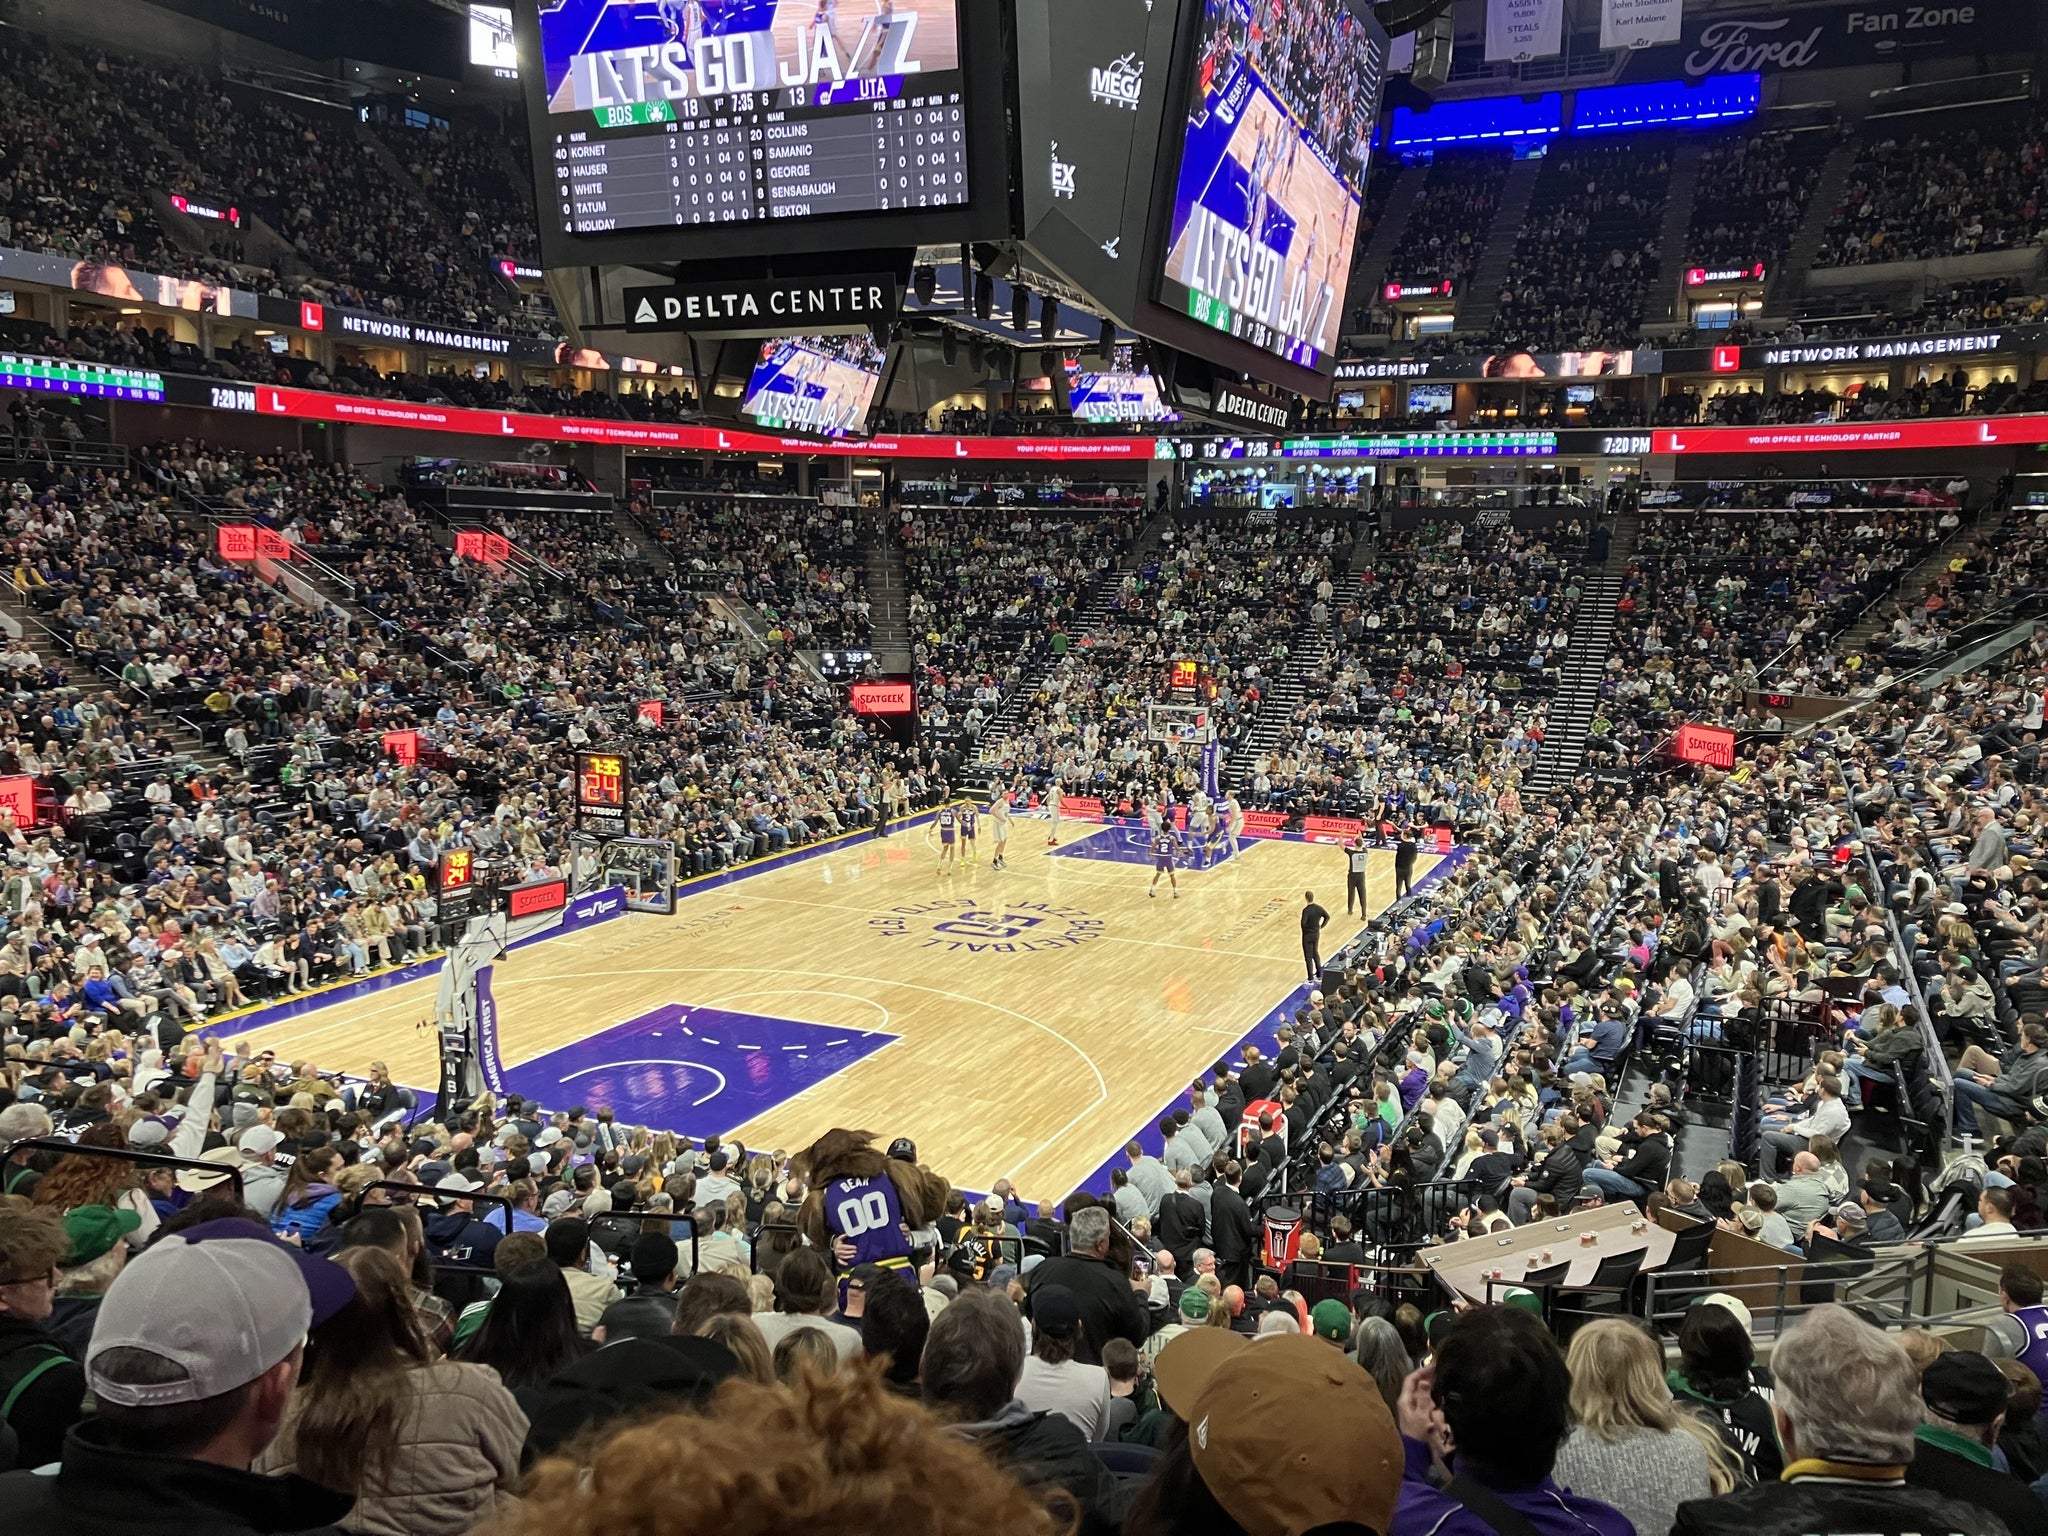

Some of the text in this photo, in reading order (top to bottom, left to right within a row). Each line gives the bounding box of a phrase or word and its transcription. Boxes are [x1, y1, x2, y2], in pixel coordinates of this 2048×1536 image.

[1507, 22, 1540, 33] STEALS
[1616, 14, 1667, 26] Karl Malone
[1848, 6, 1975, 33] Fan Zone
[1684, 17, 1823, 76] Ford
[588, 11, 921, 109] LET'S GO JAZZ
[859, 77, 888, 97] UTA
[731, 93, 754, 112] 7:35
[762, 94, 769, 106] 6
[789, 87, 805, 106] 13
[608, 106, 633, 124] BOS
[683, 99, 698, 117] 18
[767, 112, 784, 122] NAME
[912, 98, 924, 107] AST
[570, 132, 586, 142] NAME
[699, 119, 710, 129] AST
[751, 110, 959, 141] 20 COLLINS 2 1 0 04 0
[556, 132, 741, 159] 40 KORNET 2 0 2 04 1
[752, 131, 960, 160] 19 SAMANIC 2 1 0 04 0
[558, 150, 744, 177] 30 HAUSER 3 0 1 04 0
[756, 164, 810, 179] 3 GEORGE
[562, 183, 602, 196] 9 WHITE
[758, 182, 836, 199] 8 SENSABAUGH
[563, 201, 606, 215] 0 TATUM
[759, 204, 810, 218] 2 SEXTON
[565, 219, 616, 232] 4 HOLIDAY
[504, 264, 511, 274] L
[1693, 272, 1701, 282] L
[1718, 271, 1740, 279] OLSON
[1192, 209, 1334, 350] LET'S GO JAZZ
[1390, 288, 1397, 296] L
[664, 286, 883, 320] DELTA CENTER
[1195, 294, 1211, 322] BOS
[306, 307, 510, 353] L NETWORK MANAGEMENT
[1278, 334, 1285, 356] 13
[1719, 334, 2002, 368] L NETWORK MANAGEMENT
[1334, 362, 1430, 378] ANAGEMENT
[211, 388, 255, 411] 7:20 PM
[273, 392, 286, 411] L
[758, 391, 794, 421] LET'S
[794, 395, 816, 422] GO
[335, 404, 446, 422] YOUR OFFICE TECHNOLOGY PARTNER
[1118, 401, 1139, 417] GO
[1228, 394, 1288, 428] DELTA CENTER
[502, 416, 514, 433] L
[561, 426, 679, 440] YOUR OFFICE TECHNOLOGY PARTNER
[1981, 422, 1997, 442] L
[718, 432, 731, 448] L
[1604, 437, 1650, 453] 7:20 PM
[1671, 433, 1686, 451] L
[1749, 431, 1900, 445] YOUR OFFICE TECHNOLOGY PARTNER
[955, 440, 968, 456] L
[1016, 444, 1130, 454] YOUR OFFICE TECHNOLOGY PARTNER
[1180, 444, 1193, 458] 18
[1203, 443, 1217, 457] 13
[1247, 442, 1268, 456] 7:35
[1173, 671, 1195, 686] 24
[860, 693, 904, 704] SEATGEEK
[1688, 738, 1728, 754] SEATGEEK
[592, 758, 621, 776] 7:35
[586, 774, 618, 803] 24
[592, 807, 622, 818] TISSOT
[940, 816, 952, 824] 20
[1248, 814, 1282, 824] SEATGEEK
[1160, 844, 1168, 853] 2
[448, 868, 464, 885] 24
[520, 890, 557, 908] SEATGEEK
[1005, 900, 1090, 918] JAZZ
[920, 919, 1105, 953] BASKETBALL
[482, 1000, 492, 1036] FIRST
[484, 1036, 503, 1092] AMERICA
[840, 1178, 870, 1194] BEAR
[838, 1191, 890, 1237] 00
